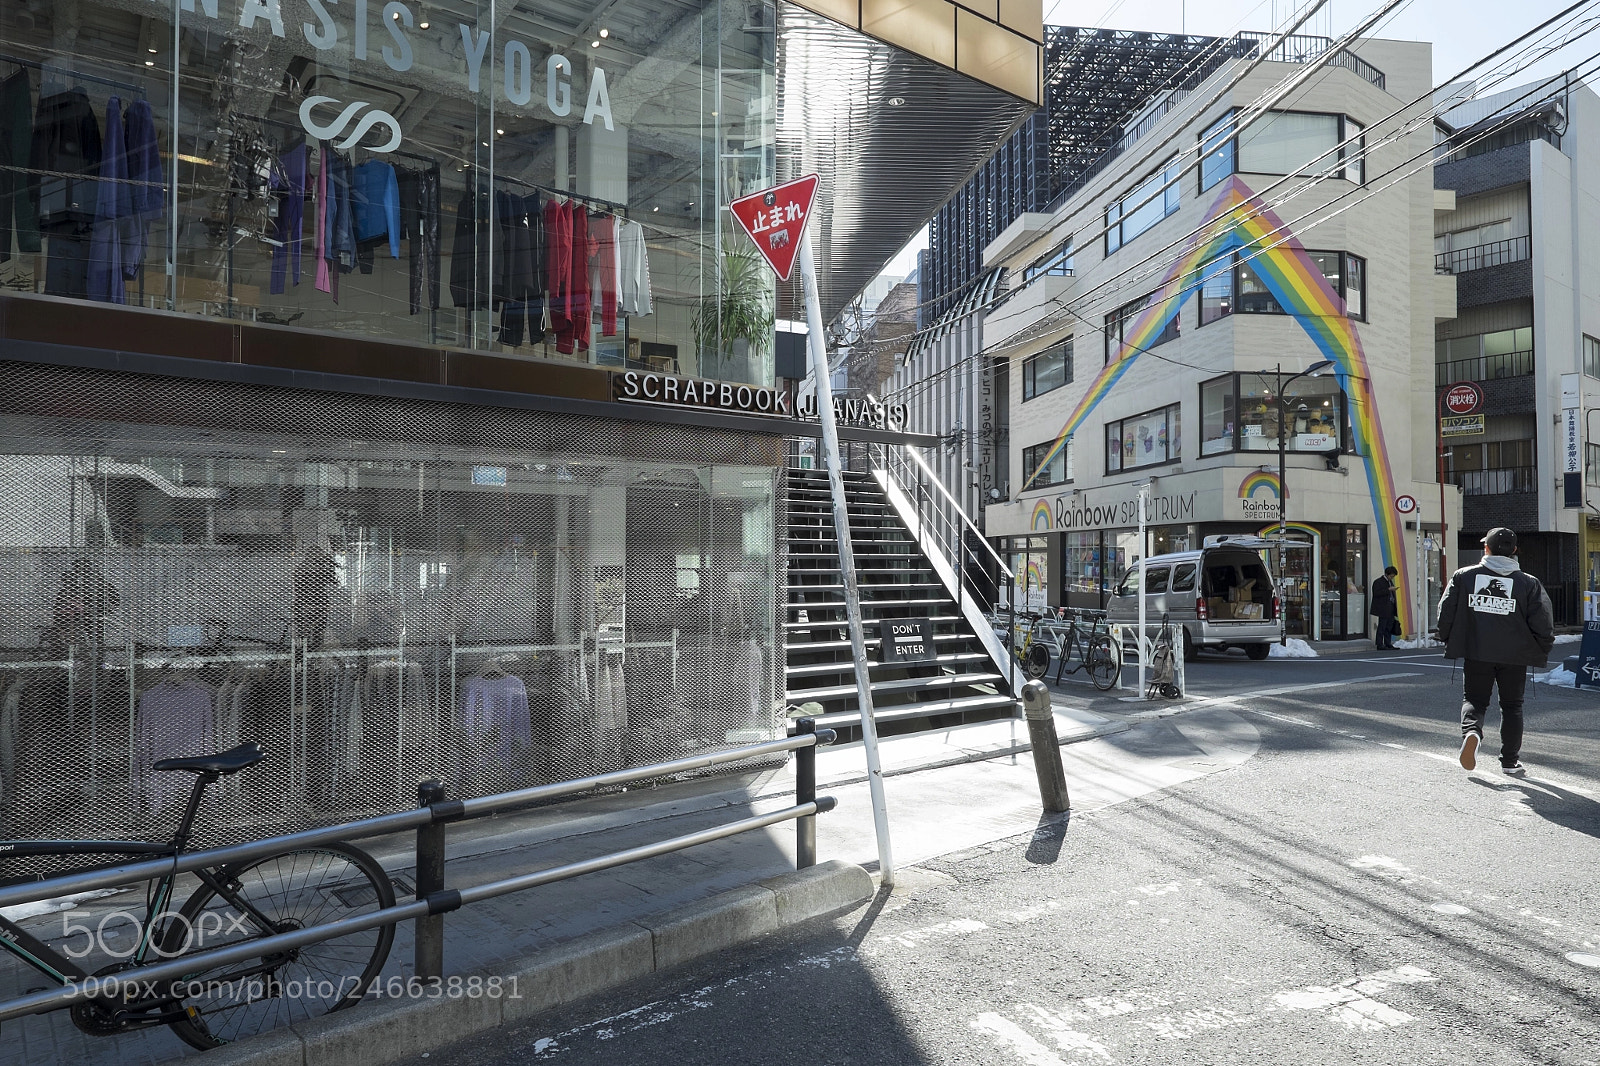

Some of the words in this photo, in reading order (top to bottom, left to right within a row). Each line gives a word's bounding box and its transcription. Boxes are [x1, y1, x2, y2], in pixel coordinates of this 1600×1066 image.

[459, 23, 615, 132] YOGA
[752, 200, 804, 234] 止まれ
[624, 371, 788, 413] SCRAPBOOK
[796, 394, 910, 429] (JANASIS)
[1450, 393, 1475, 405] 消火栓
[1448, 417, 1478, 427] パソコン
[1056, 494, 1117, 528] Rainbow
[892, 623, 921, 634] DON'T
[895, 645, 925, 655] ENTER
